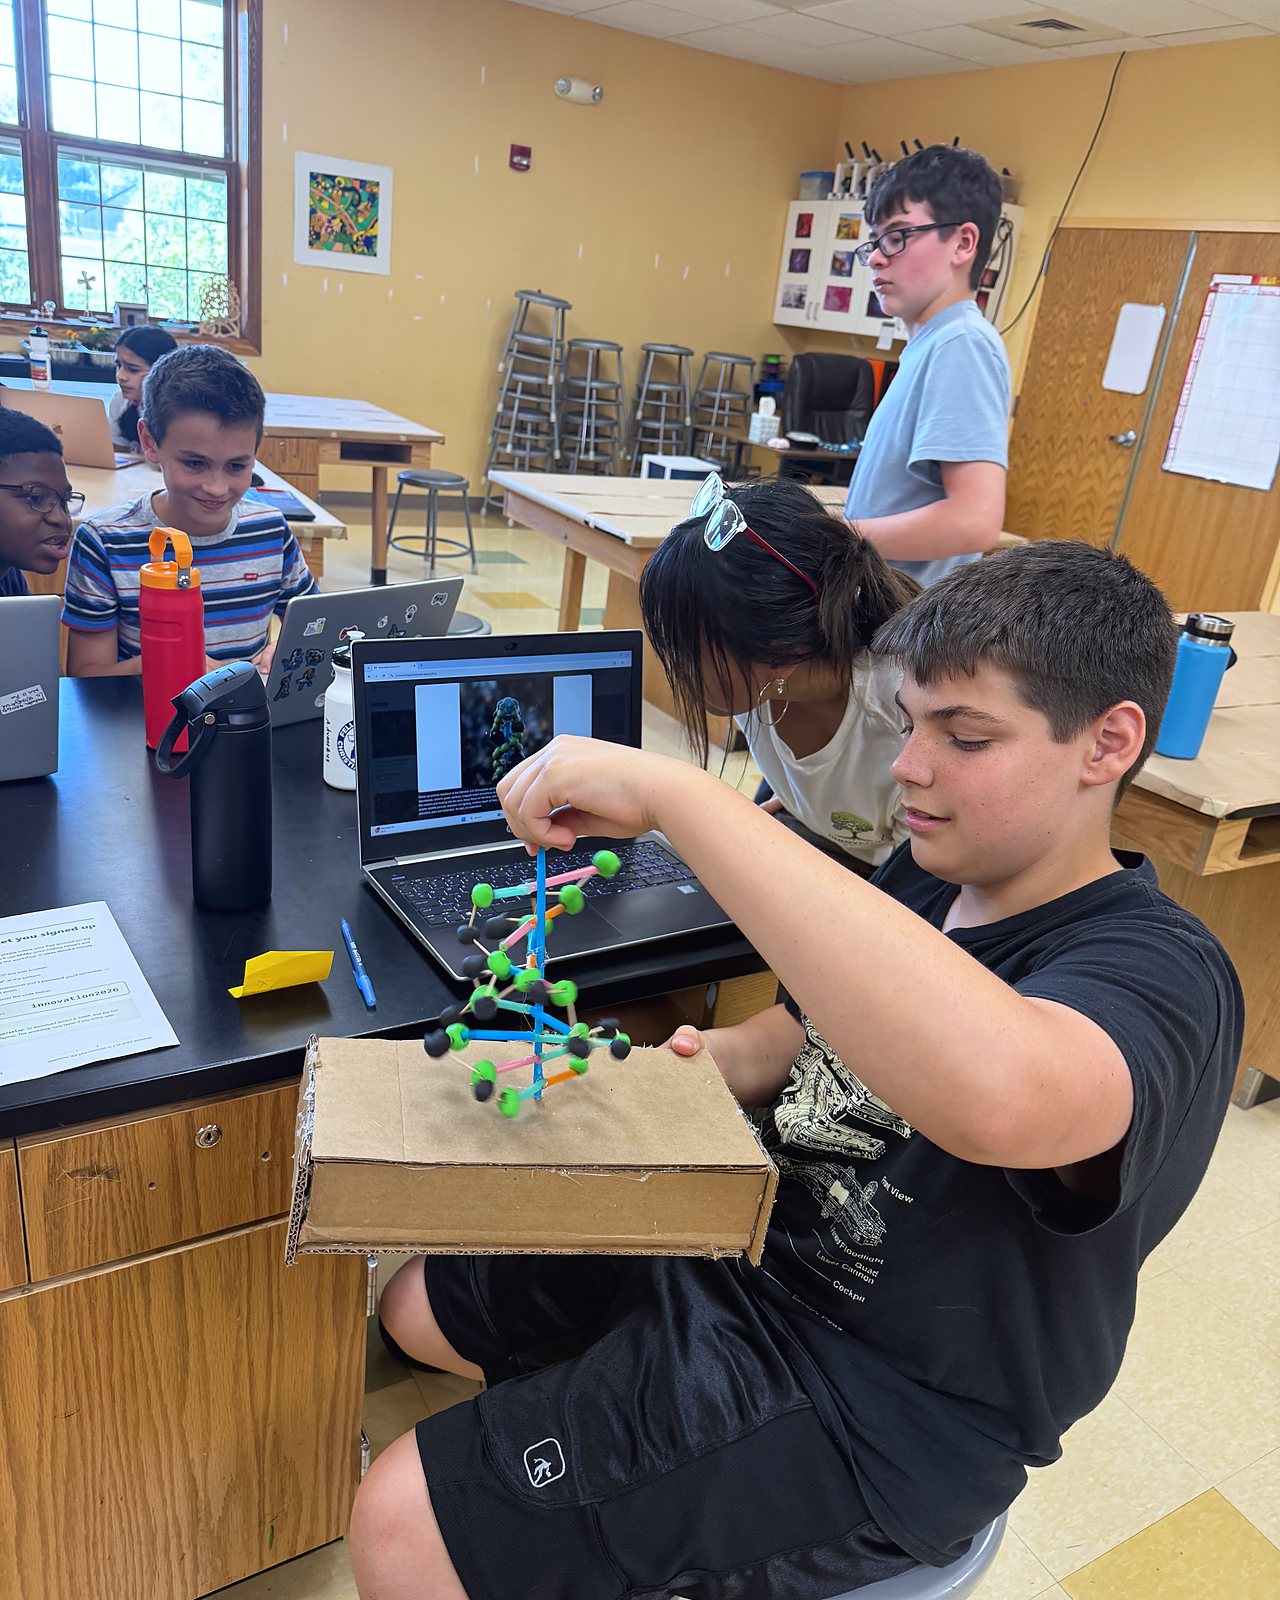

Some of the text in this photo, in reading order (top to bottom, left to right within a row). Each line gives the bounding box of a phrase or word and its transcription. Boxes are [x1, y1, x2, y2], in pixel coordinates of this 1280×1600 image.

[337, 740, 356, 770] CHRISTI
[15, 934, 38, 942] you
[40, 926, 79, 937] signed
[31, 986, 119, 1009] innovation2026
[891, 1187, 914, 1204] View
[839, 1242, 884, 1265] Floodlight
[842, 1263, 875, 1285] Cannon
[855, 1262, 879, 1278] Quad
[833, 1280, 865, 1303] Cockpit
